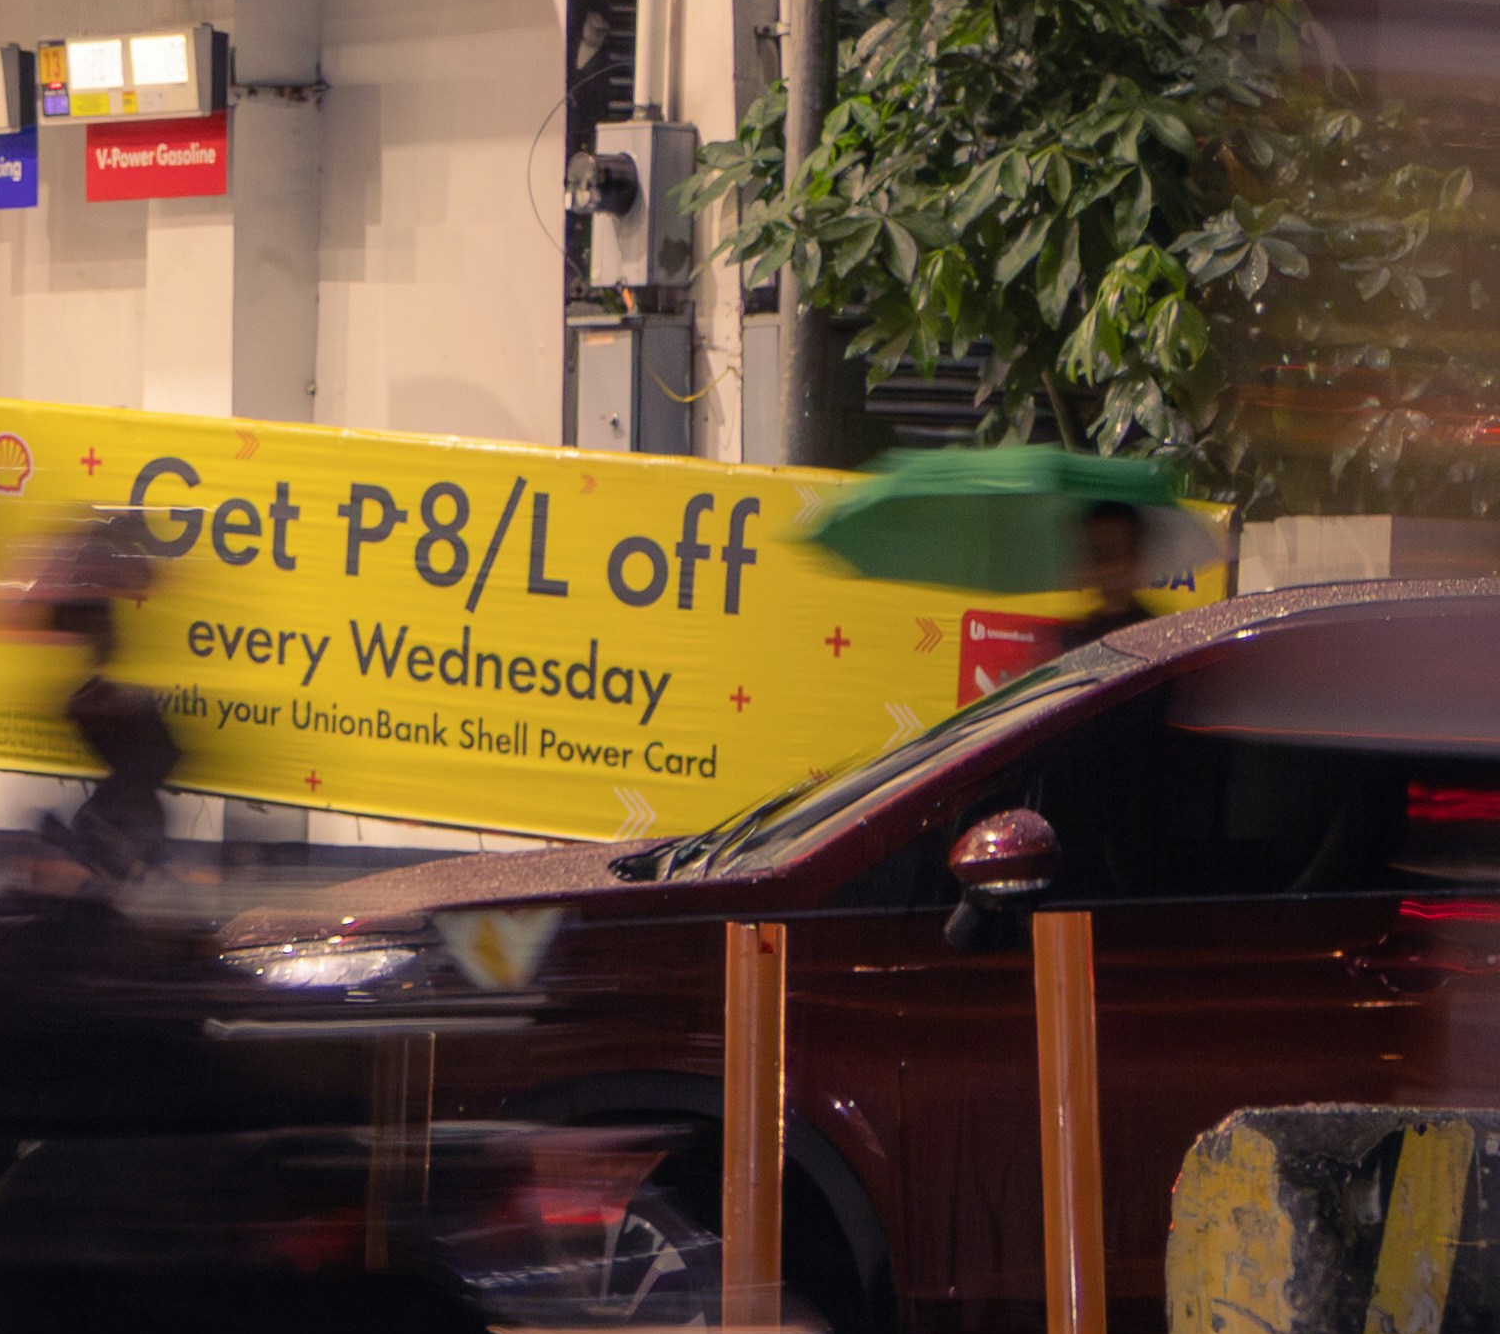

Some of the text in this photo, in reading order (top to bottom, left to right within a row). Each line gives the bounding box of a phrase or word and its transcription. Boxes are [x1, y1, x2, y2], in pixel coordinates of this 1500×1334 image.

[96, 142, 216, 169] V-Power Gasoline
[130, 456, 300, 572] Get
[607, 492, 761, 615] off
[187, 618, 672, 726] every Wednesday
[154, 682, 717, 779] with your UnionBank Shell Power Card
